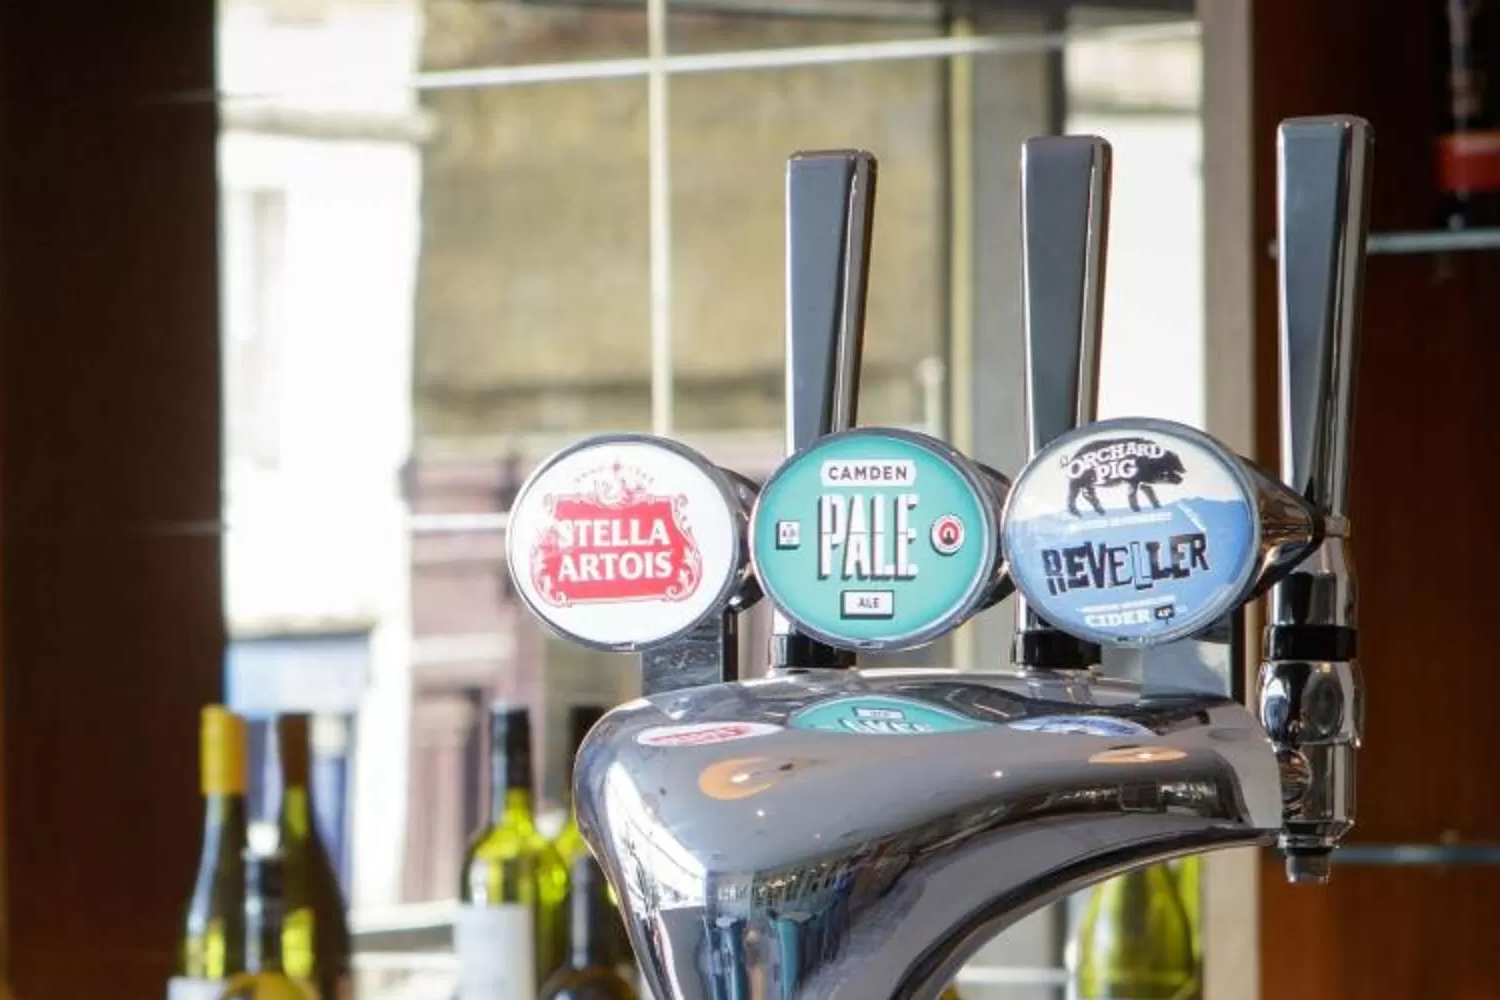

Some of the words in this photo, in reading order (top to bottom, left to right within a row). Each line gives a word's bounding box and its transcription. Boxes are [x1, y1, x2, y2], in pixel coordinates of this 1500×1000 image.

[828, 465, 908, 481] CAMDEN
[1068, 442, 1165, 479] ORCHARD
[1094, 459, 1138, 485] PIG
[557, 518, 670, 547] STELLA
[817, 493, 919, 580] PALE
[558, 550, 673, 582] ARTOIS
[1041, 532, 1210, 596] REVELLER
[857, 598, 880, 608] ALE
[1084, 609, 1151, 628] CIDER
